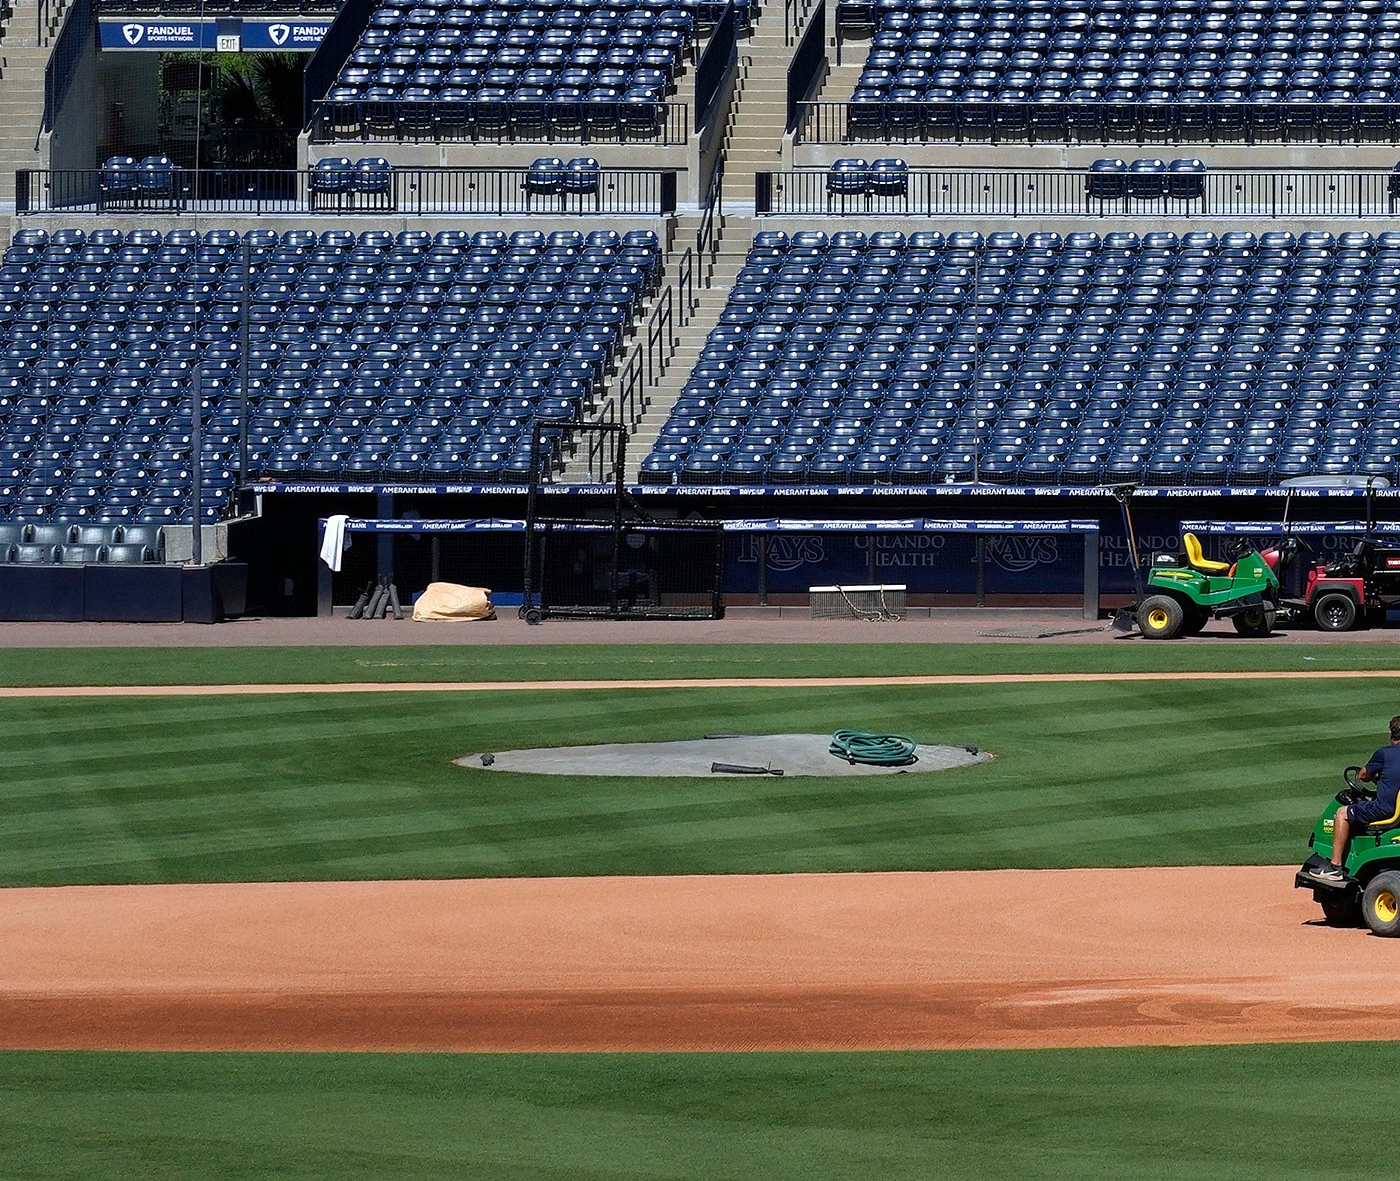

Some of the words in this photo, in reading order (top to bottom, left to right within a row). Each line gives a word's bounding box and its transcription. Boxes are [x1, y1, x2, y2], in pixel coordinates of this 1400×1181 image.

[147, 26, 194, 36] FANDUEL
[293, 26, 329, 36] FANDU
[221, 38, 236, 49] EXIT
[481, 487, 517, 495] AMERANT
[578, 487, 614, 495] AMERANT
[676, 487, 712, 495] AMERANT
[712, 487, 731, 495] BANK
[970, 488, 1006, 496] AMERANT
[1006, 488, 1025, 496] BANK
[1301, 489, 1320, 497] BANK
[854, 535, 945, 548] ORLANDO
[971, 536, 1058, 571] RAYS
[865, 552, 936, 566] HEALTH
